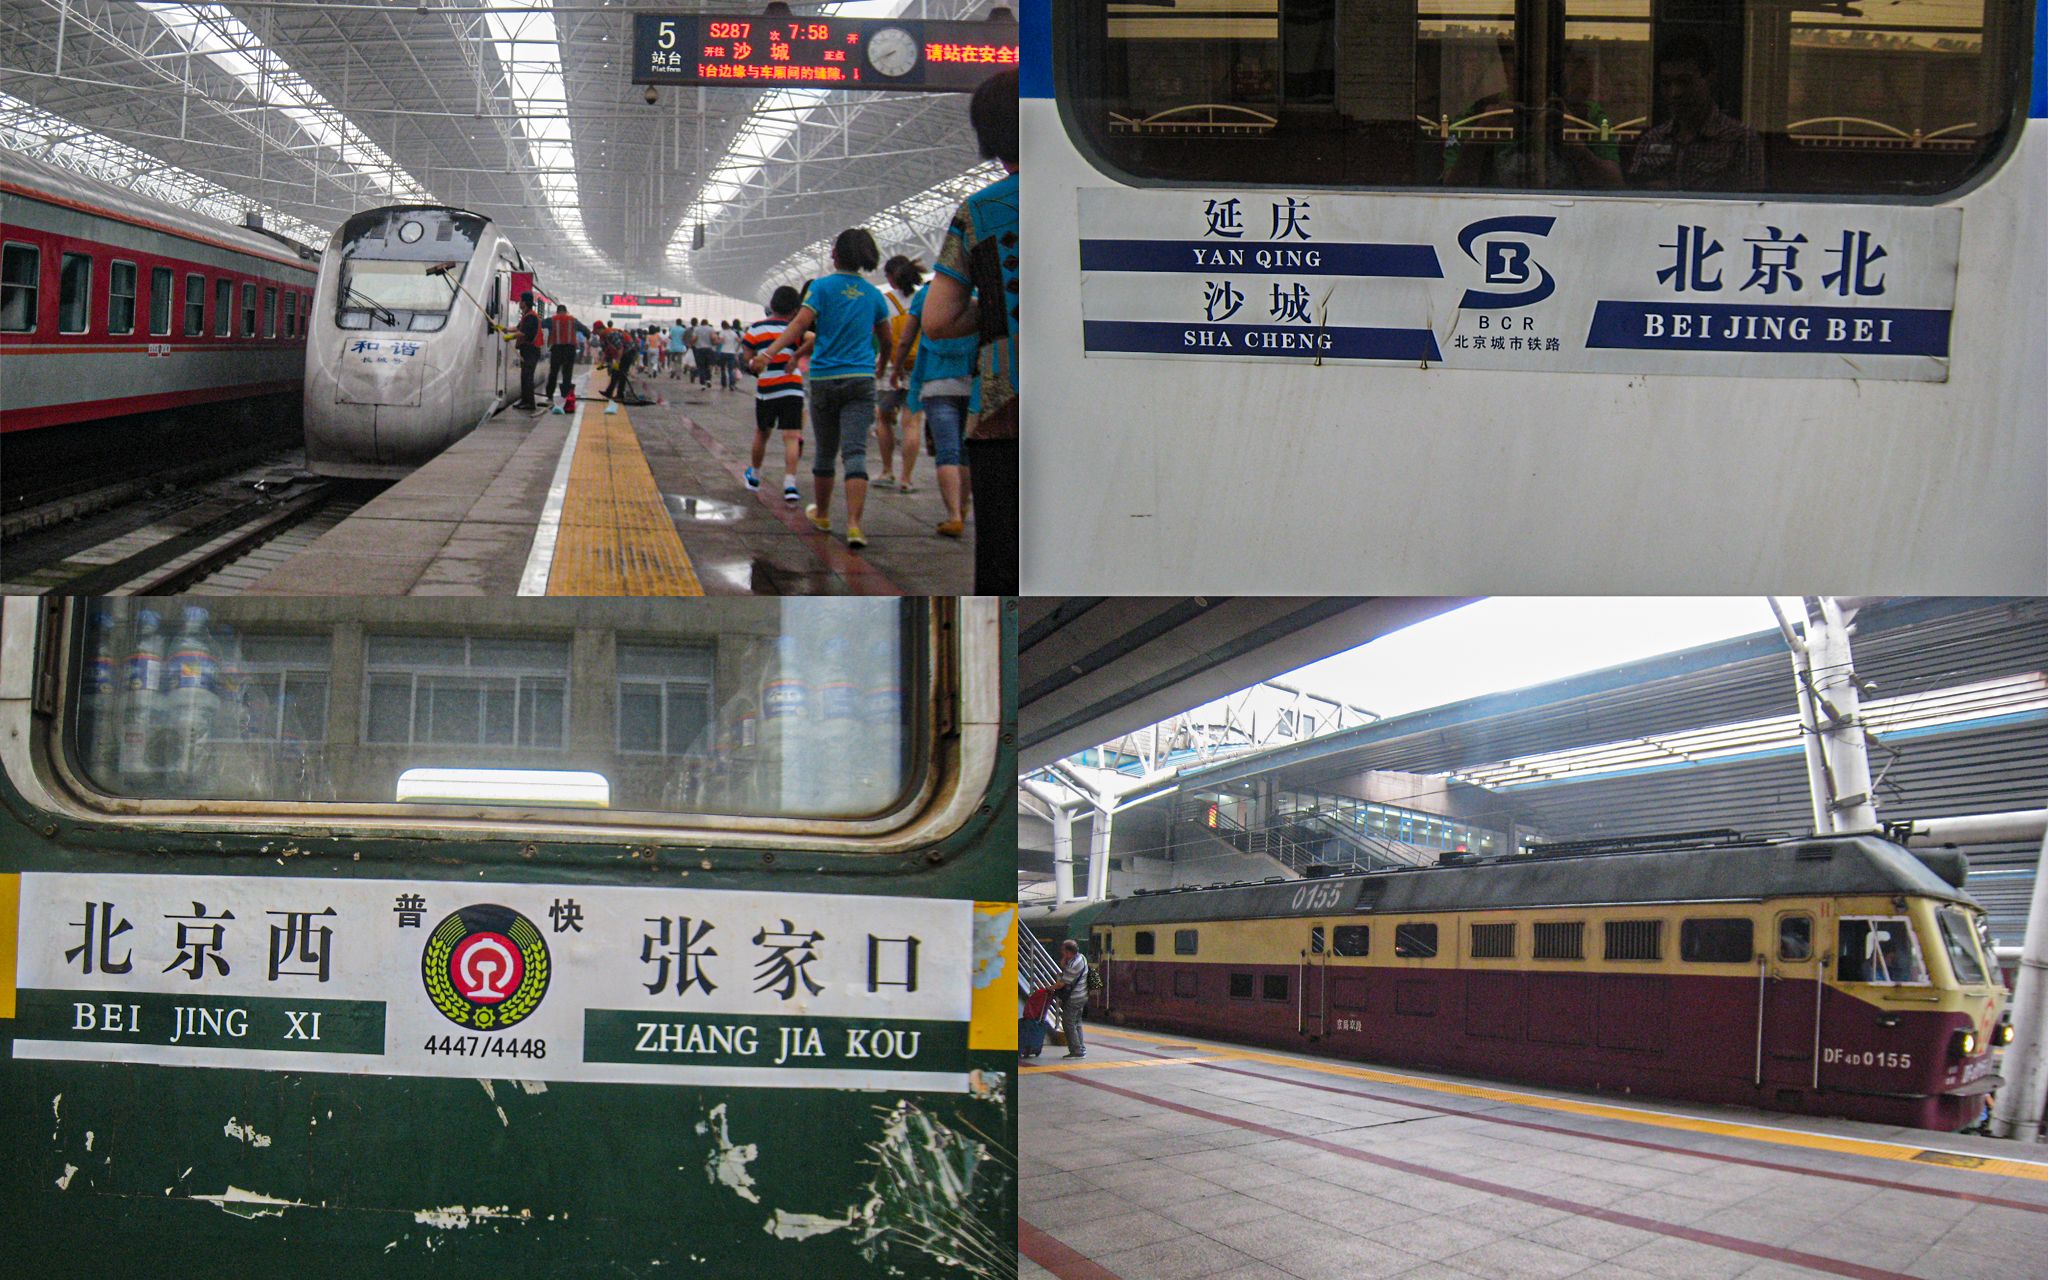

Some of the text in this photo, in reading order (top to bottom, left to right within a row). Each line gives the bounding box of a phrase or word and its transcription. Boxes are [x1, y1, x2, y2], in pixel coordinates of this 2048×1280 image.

[658, 21, 676, 49] 5
[710, 23, 752, 38] S287
[769, 30, 781, 41] 次
[788, 24, 829, 40] 7:58
[651, 51, 682, 65] 站台
[704, 47, 725, 57] 开往
[733, 42, 790, 61] 沙城
[1203, 197, 1312, 240] 延庆
[1193, 248, 1322, 268] YAN QING
[1656, 224, 1888, 296] 北京北
[1203, 280, 1312, 324] 沙城
[1184, 330, 1333, 350] SHA CHENG
[1644, 313, 1893, 343] BEI JING BEI
[350, 340, 420, 356] 和谐
[1454, 334, 1561, 352] 北京城市铁路
[1292, 882, 1344, 910] 0155
[394, 893, 584, 933] 普 快
[65, 900, 337, 983] 北京西
[640, 916, 923, 1001] 张家口
[72, 1002, 321, 1043] BEI JING XI
[424, 1034, 546, 1060] 4447/4448
[635, 1023, 921, 1064] ZHANG JIA KOU
